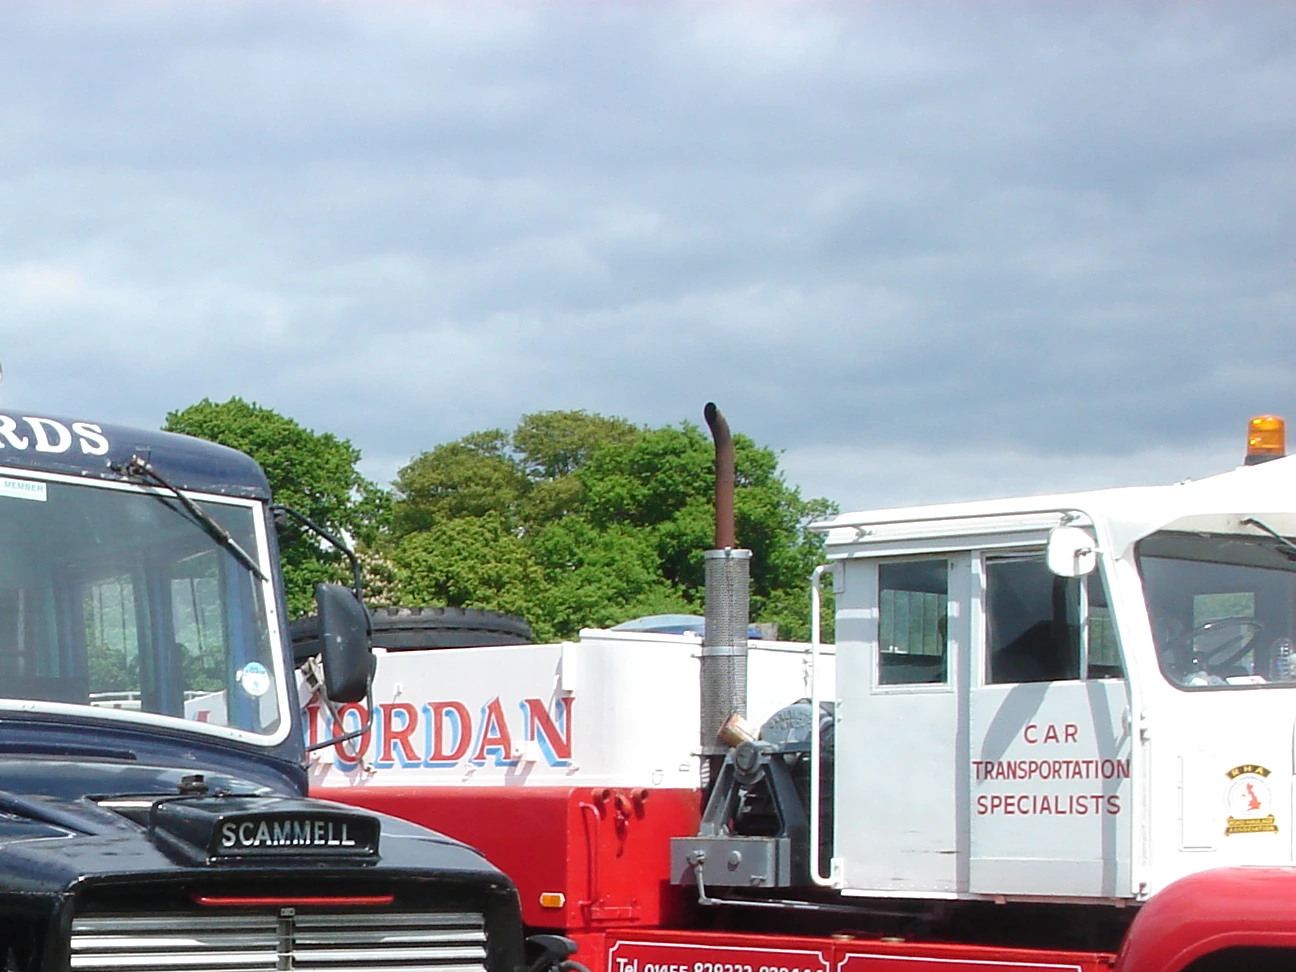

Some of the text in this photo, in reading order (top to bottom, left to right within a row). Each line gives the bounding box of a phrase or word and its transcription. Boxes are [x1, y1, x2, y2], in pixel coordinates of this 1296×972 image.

[4, 480, 44, 493] MEMBER
[1023, 724, 1079, 744] CAR
[972, 759, 1131, 780] TRANSPORTATION
[976, 795, 1121, 815] SPECIALISTS
[222, 820, 355, 847] SCAMMELL
